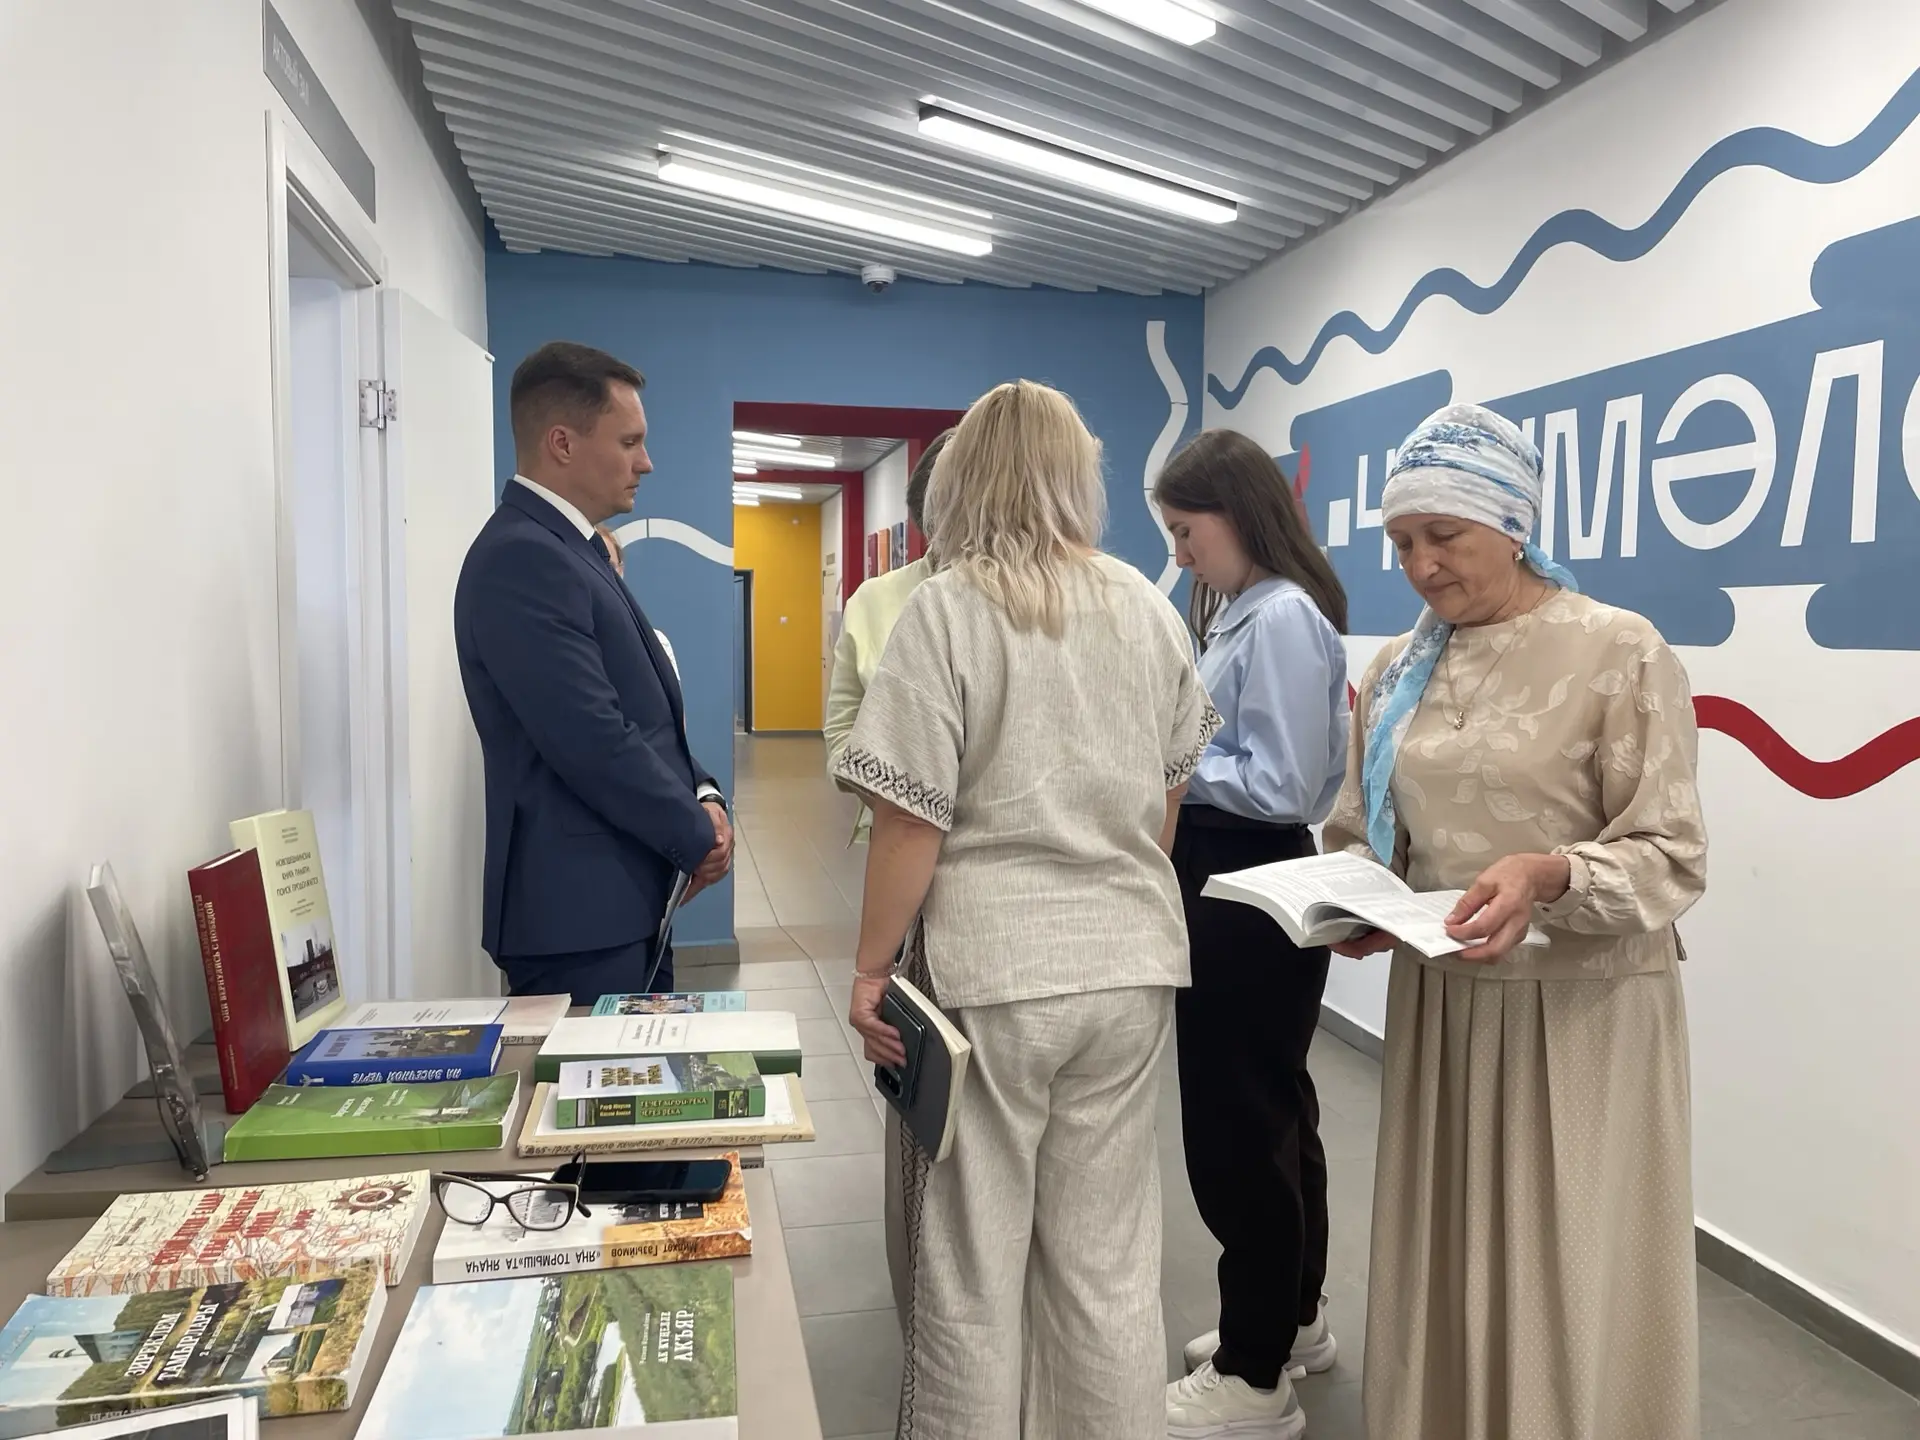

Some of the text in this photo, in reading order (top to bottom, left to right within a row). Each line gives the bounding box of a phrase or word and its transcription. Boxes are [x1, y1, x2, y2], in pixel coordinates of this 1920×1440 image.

[204, 901, 219, 942] ПОБЕДОЙ
[213, 951, 229, 1002] ВЕРНУЛИСЬ
[219, 1002, 230, 1023] ОНИ
[350, 1067, 462, 1085] НА ЗАСЕЧНОЙ ЧЕРТЕ
[505, 1252, 570, 1269] ТОРМЫШ»ТА
[574, 1248, 601, 1265] «ЯҢА
[610, 1243, 659, 1258] Газыймов
[465, 1259, 500, 1273] ЯҢАЧА
[124, 1312, 181, 1377] ЗИРЕКЛЕМ
[156, 1303, 219, 1381] ТАМЫРЛАРЫ
[673, 1310, 694, 1362] АКЪЯР
